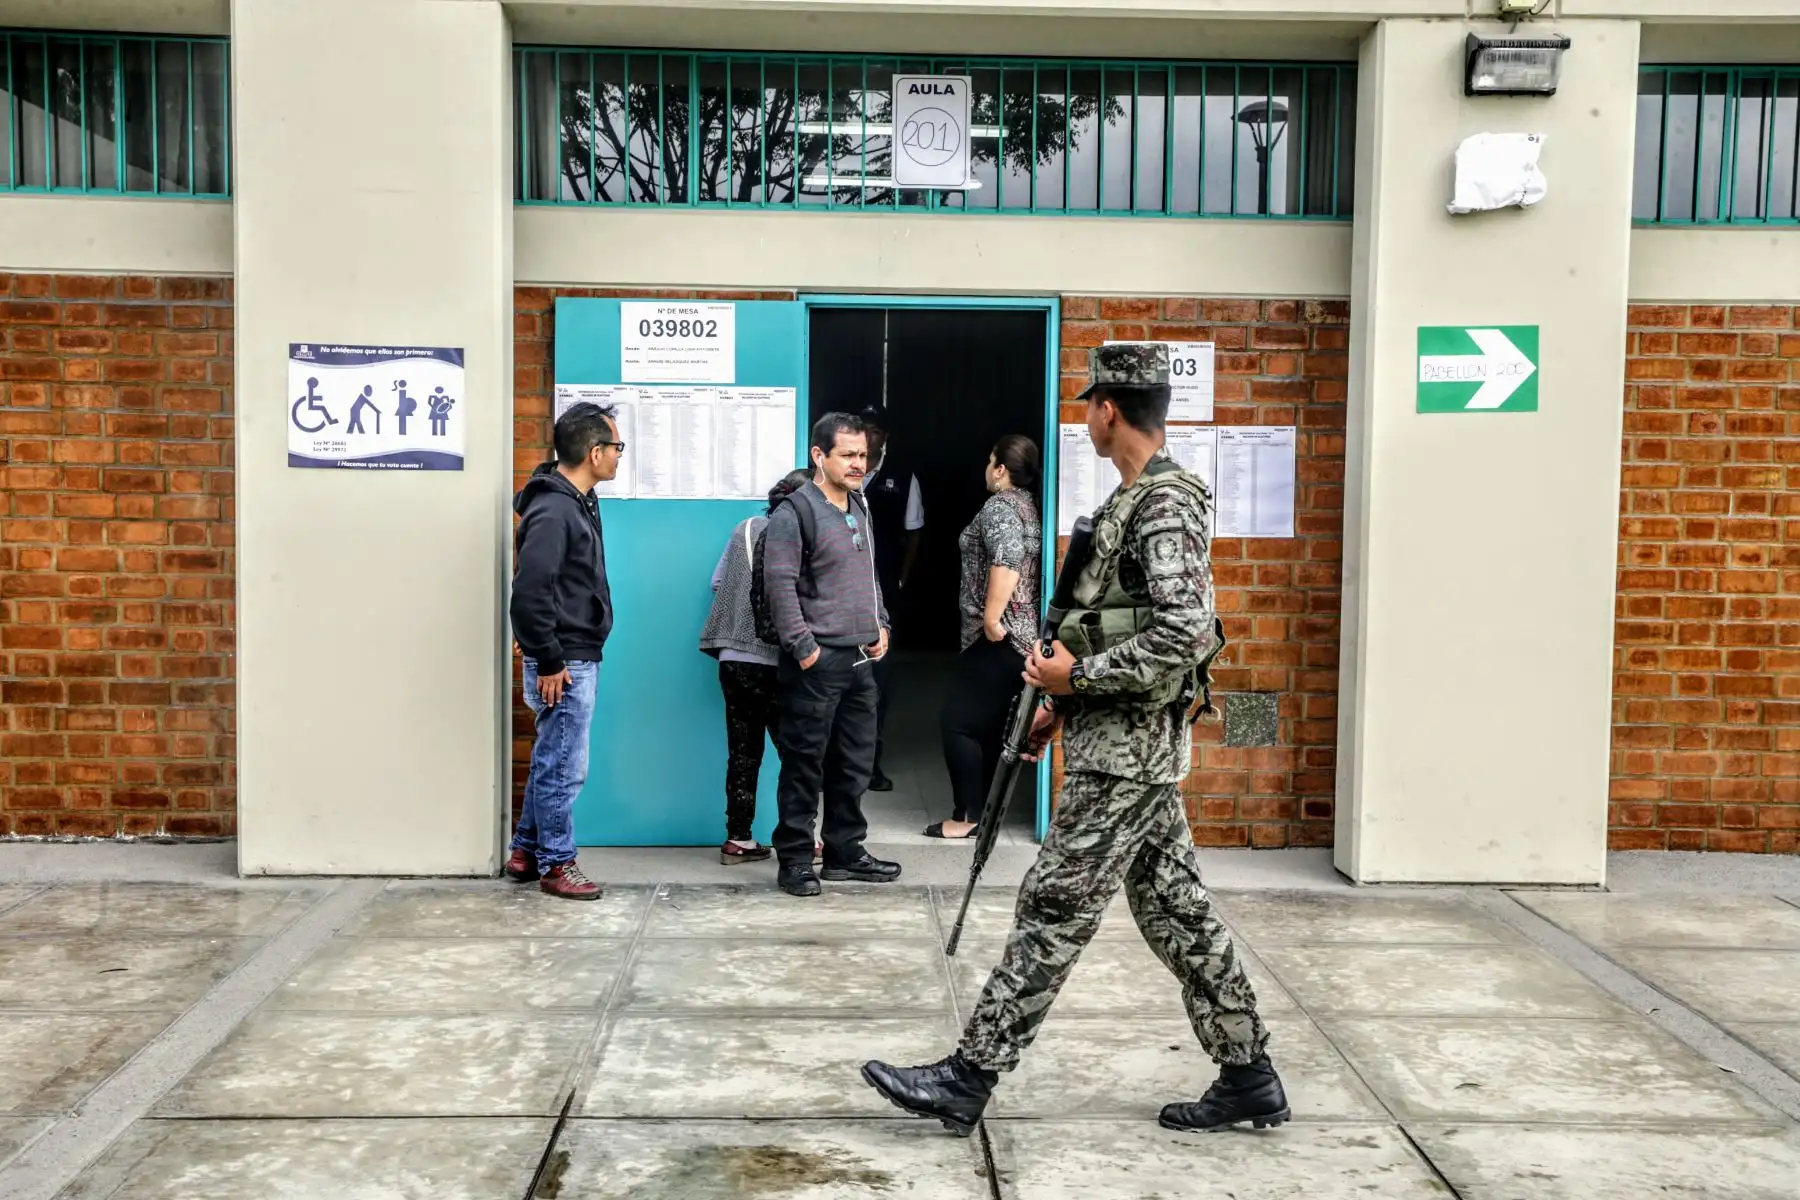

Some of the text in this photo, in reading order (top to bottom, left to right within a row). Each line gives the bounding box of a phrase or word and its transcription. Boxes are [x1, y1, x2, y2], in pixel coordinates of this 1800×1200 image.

[908, 83, 956, 96] AULA
[902, 119, 954, 153] 201
[639, 319, 718, 338] 039802
[331, 346, 363, 354] olvidemos
[1423, 362, 1528, 380] PABELLON 200
